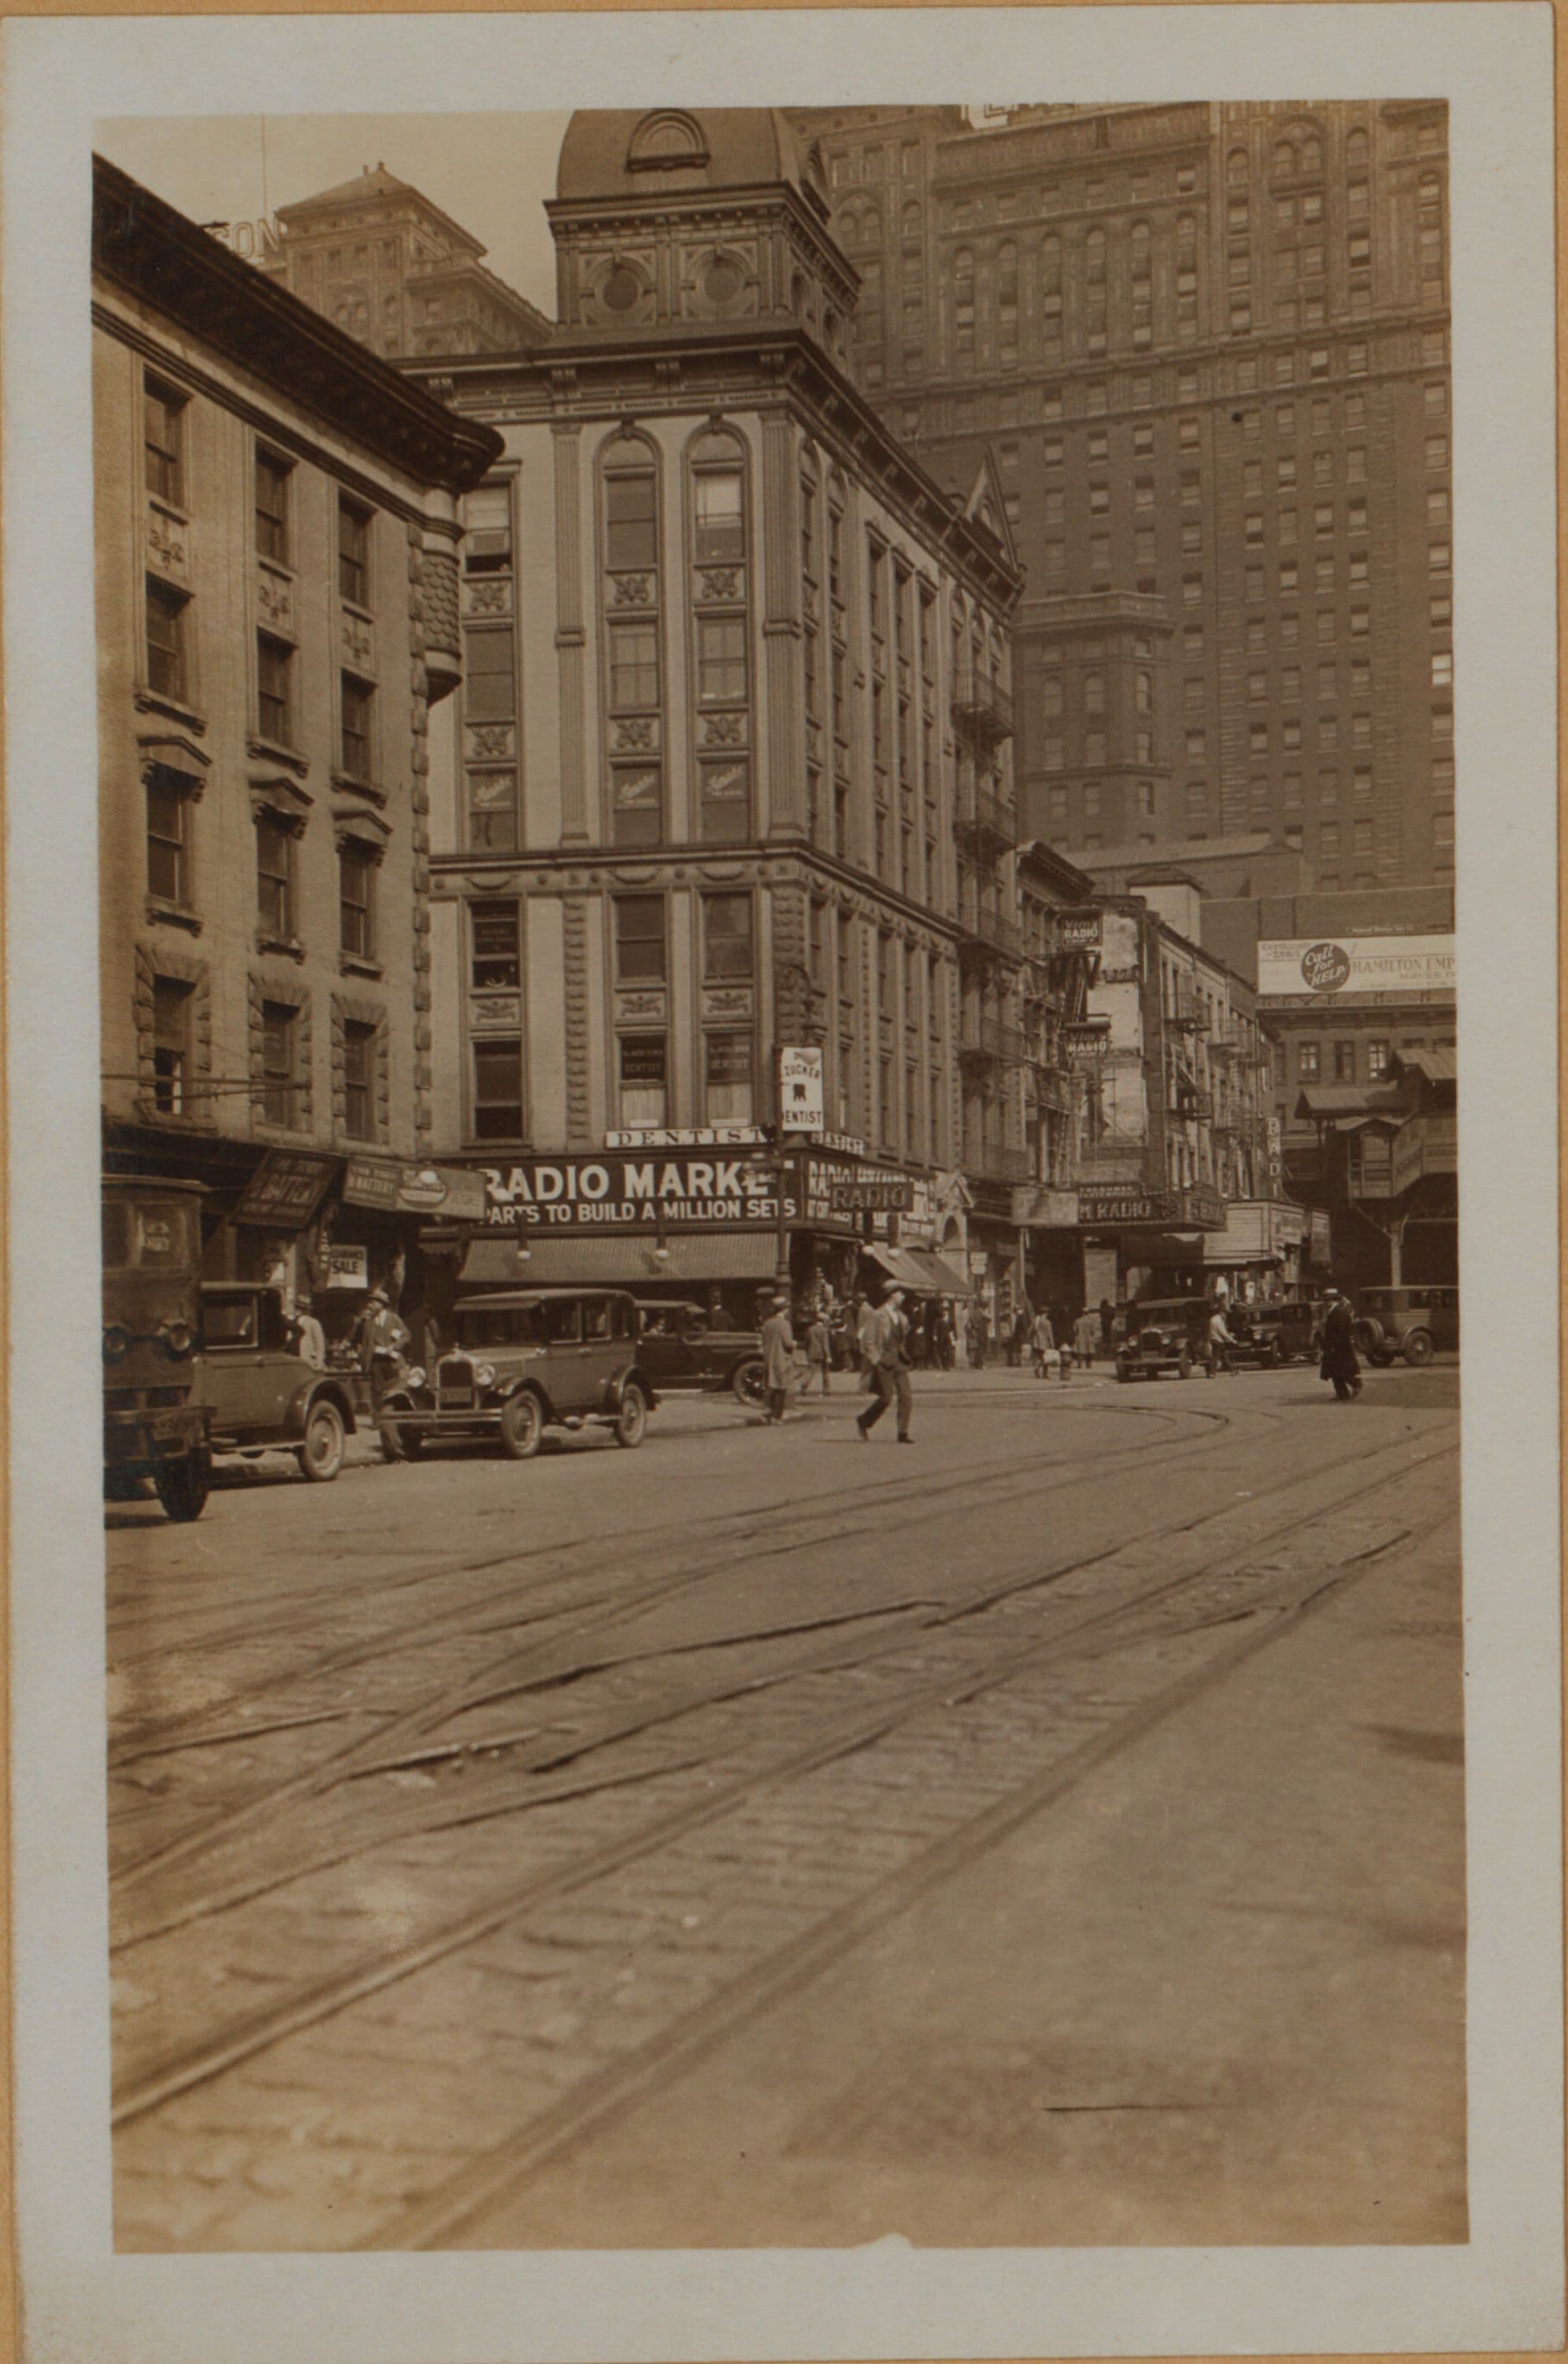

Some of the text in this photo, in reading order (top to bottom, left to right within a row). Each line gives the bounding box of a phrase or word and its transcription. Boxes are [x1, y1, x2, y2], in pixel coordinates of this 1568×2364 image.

[1064, 929, 1098, 939] RADIO
[1305, 944, 1333, 966] Call
[1307, 959, 1335, 978] for
[1352, 957, 1422, 974] HAMILTON
[1310, 965, 1346, 989] HELP
[783, 1109, 821, 1124] ENTIST
[618, 1128, 764, 1147] DENTIST
[478, 1165, 609, 1201] RADIO
[624, 1160, 794, 1198] MARKE
[832, 1186, 906, 1209] RADIO
[484, 1204, 539, 1224] ARTS
[546, 1204, 572, 1223] TO
[578, 1201, 636, 1222] BUILD
[642, 1201, 656, 1220] A
[664, 1199, 741, 1220] MILLION
[332, 1260, 359, 1275] SALE
